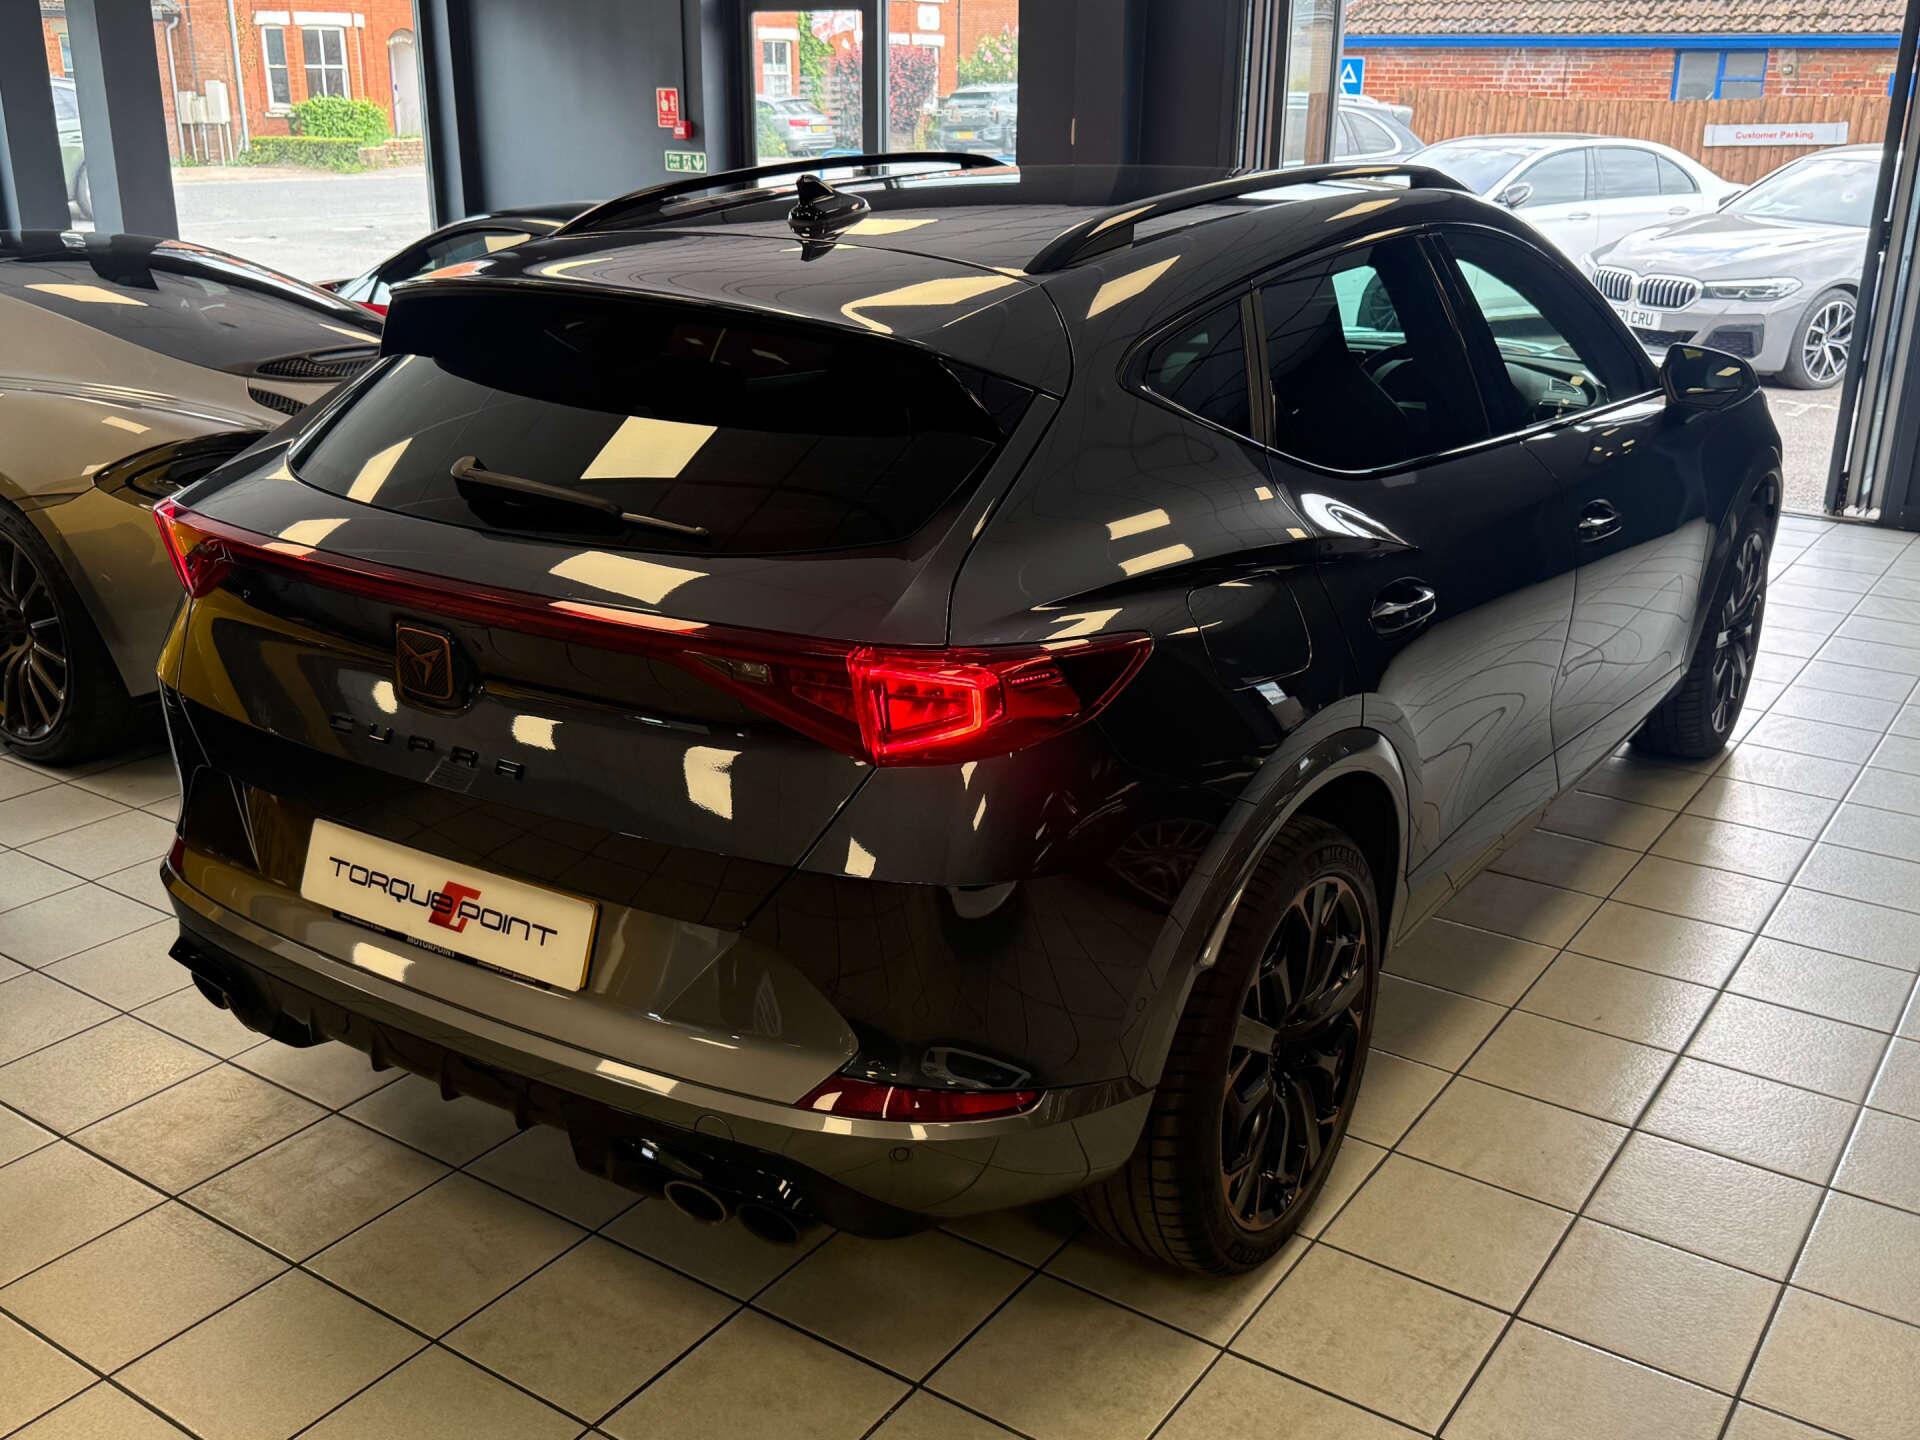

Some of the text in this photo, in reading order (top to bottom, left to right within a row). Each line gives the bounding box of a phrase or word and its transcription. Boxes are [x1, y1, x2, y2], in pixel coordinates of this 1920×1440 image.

[1735, 131, 1814, 140] Customer Parking
[1631, 311, 1654, 326] CRU
[329, 714, 525, 782] CUPRA
[329, 856, 558, 946] TORQUE POINT
